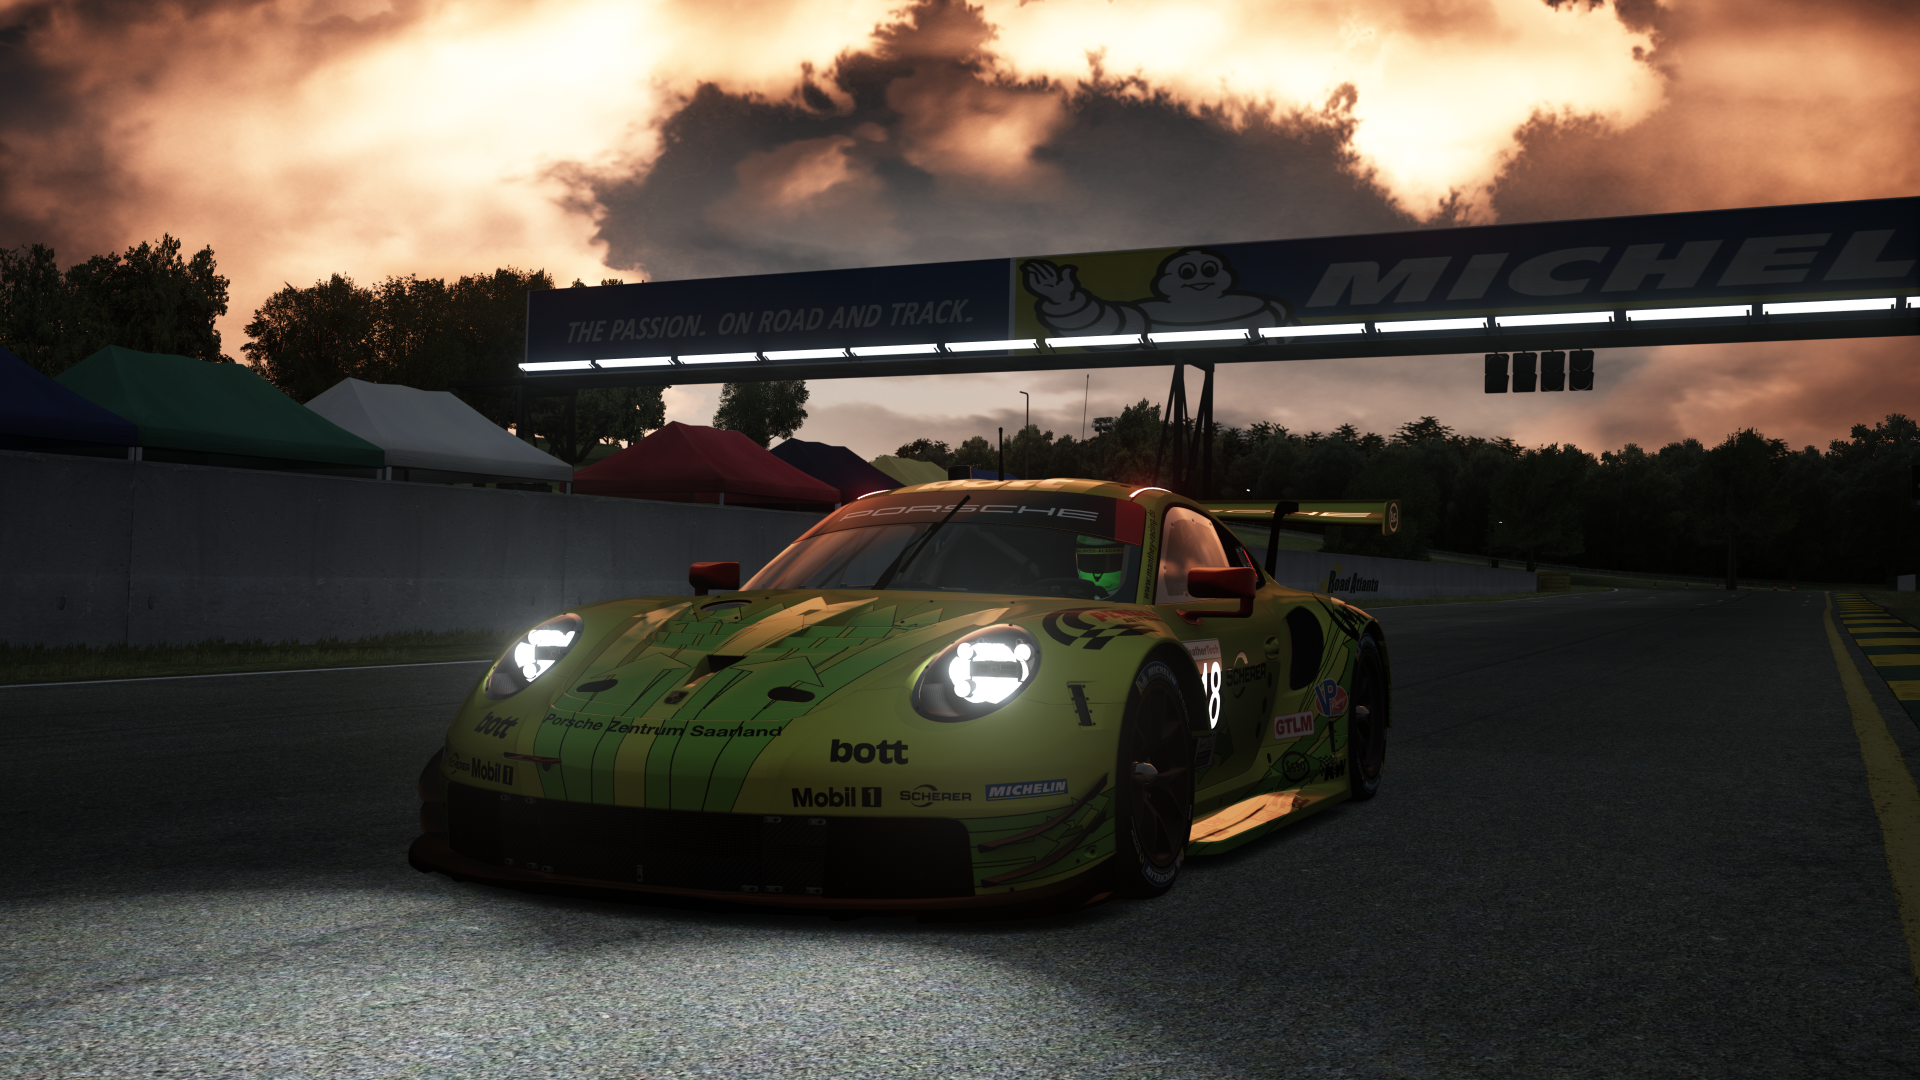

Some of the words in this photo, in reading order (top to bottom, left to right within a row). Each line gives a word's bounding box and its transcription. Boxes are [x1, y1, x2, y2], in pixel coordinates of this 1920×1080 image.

[567, 319, 605, 343] THE
[609, 314, 706, 341] PASSION.
[717, 310, 753, 336] ON
[758, 307, 823, 333] ROAD
[827, 303, 883, 330] AND
[889, 298, 974, 325] TRACK.
[839, 504, 1099, 522] PORSCHE
[1327, 570, 1351, 593] Road
[1349, 572, 1379, 593] Atlanta
[1187, 645, 1219, 656] eatherTech
[1147, 665, 1177, 686] MICHELIN
[1226, 662, 1266, 687] SCHERER
[1314, 678, 1337, 716] VP
[474, 711, 519, 739] bott
[543, 713, 602, 731] Porsche
[606, 720, 685, 737] Zentrum
[690, 725, 783, 738] Saarland
[1275, 713, 1313, 736] GTLM
[830, 739, 909, 765] bott
[448, 757, 470, 772] SCHERER
[472, 757, 501, 783] Mobil
[791, 786, 857, 807] Mobil
[899, 790, 972, 802] SCHERER
[988, 781, 1067, 798] MICHELIN
[1145, 865, 1176, 883] MICHELIN
